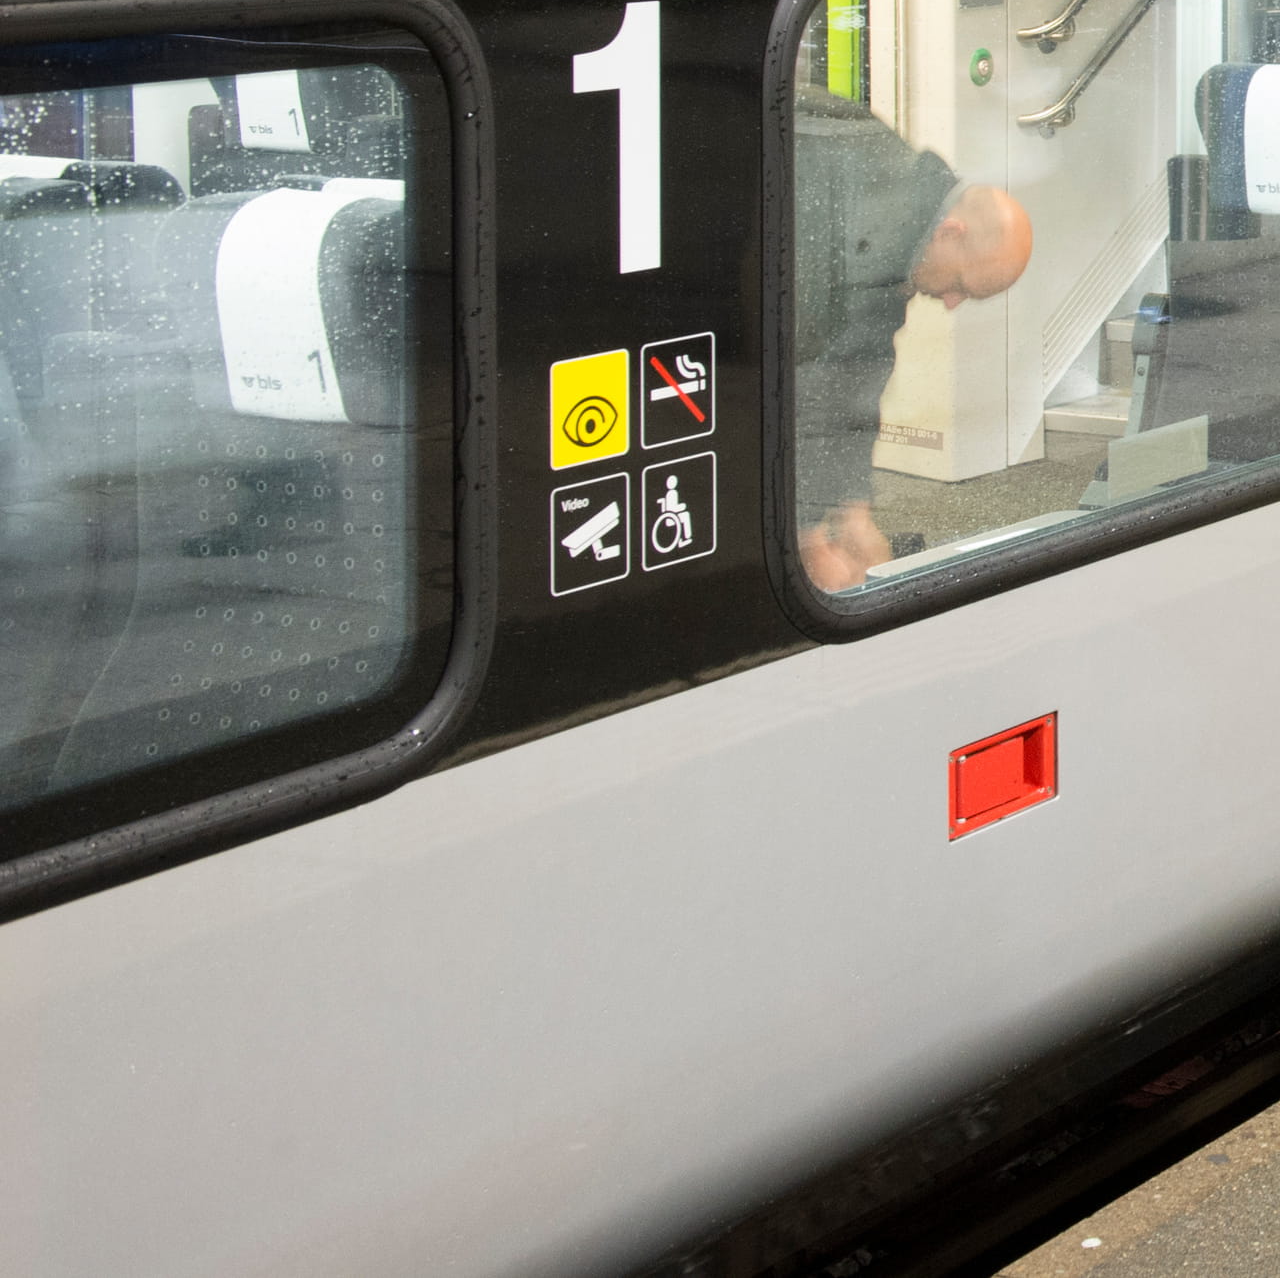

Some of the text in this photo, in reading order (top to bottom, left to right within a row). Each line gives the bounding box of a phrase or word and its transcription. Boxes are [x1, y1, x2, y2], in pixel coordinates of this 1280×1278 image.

[288, 107, 300, 136] 1
[572, 0, 661, 274] 1
[256, 349, 327, 394] bls 1
[561, 497, 590, 513] Video
